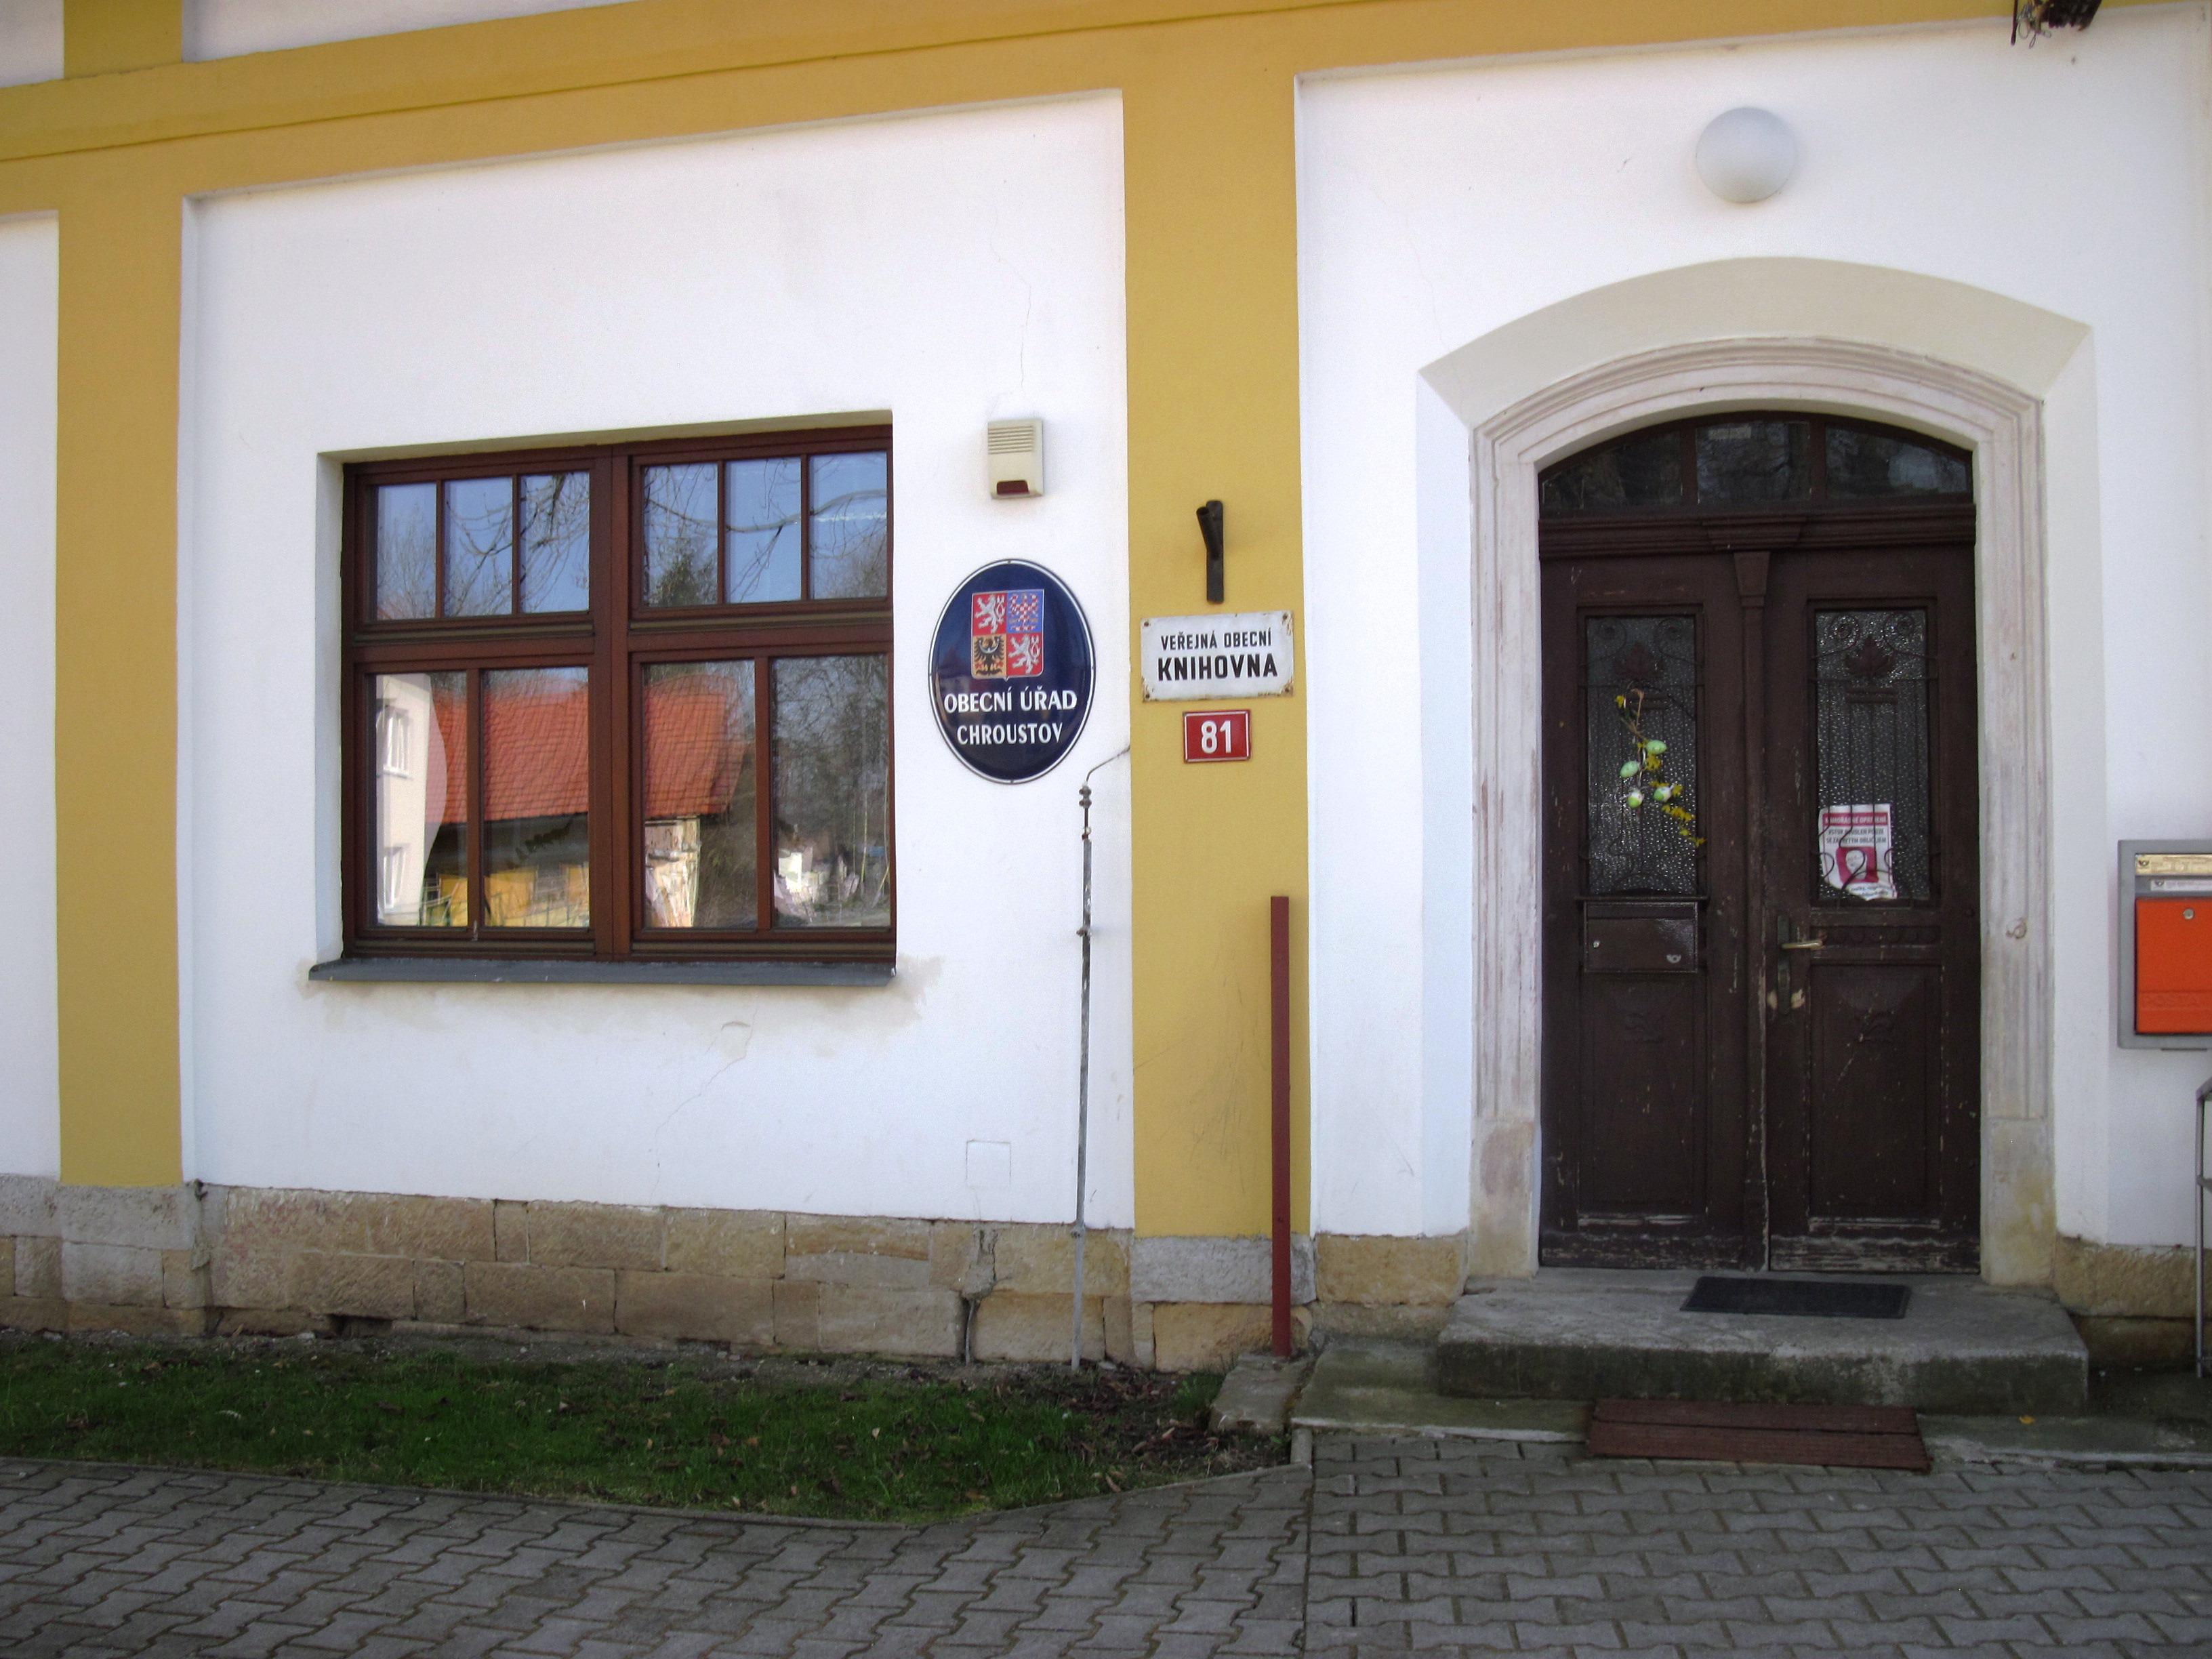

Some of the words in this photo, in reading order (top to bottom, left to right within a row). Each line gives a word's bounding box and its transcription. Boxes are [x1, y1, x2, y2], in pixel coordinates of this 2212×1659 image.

[1160, 630, 1218, 651] VEŘEJNÁ
[1224, 627, 1272, 648] OBECNÍ
[1158, 653, 1278, 682] KNIHOVNA
[943, 685, 1012, 714] OBECNÍ
[1020, 684, 1078, 712] ÚŘAD
[957, 722, 1063, 745] CHROUSTOV
[1201, 720, 1232, 754] 81
